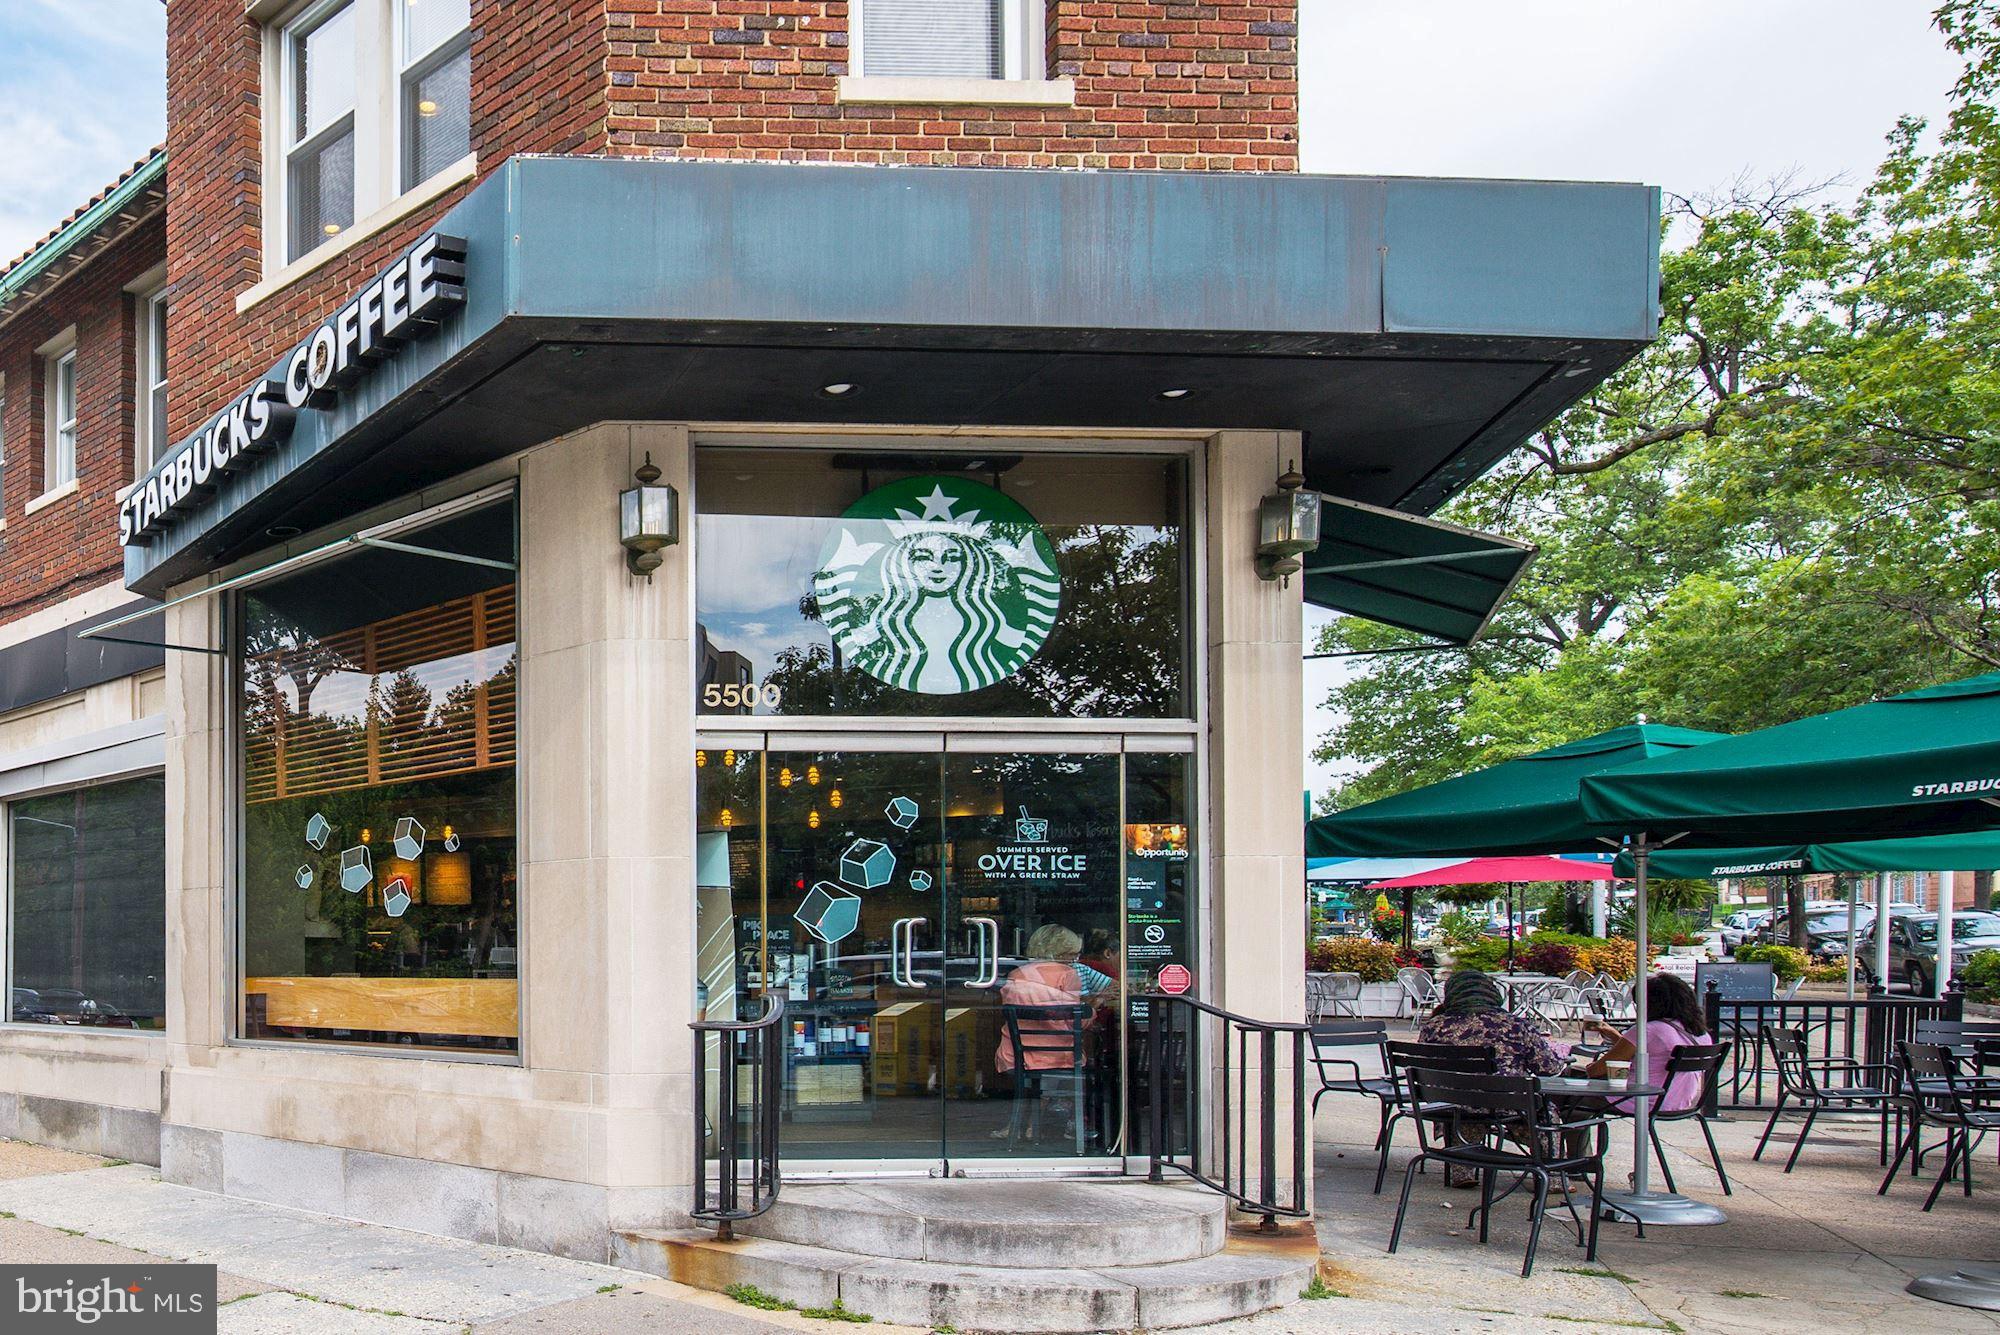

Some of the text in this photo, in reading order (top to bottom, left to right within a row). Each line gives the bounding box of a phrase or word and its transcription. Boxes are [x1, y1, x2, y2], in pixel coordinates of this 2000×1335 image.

[119, 232, 437, 546] STARBUCKS COFFEE
[703, 683, 781, 708] 5500
[996, 846, 1069, 854] SUMMER SERVED
[1136, 847, 1189, 859] Opportunity
[977, 854, 1087, 871] OVER ICE
[1711, 863, 1766, 875] STARBUCKS
[743, 920, 762, 931] PIK
[752, 930, 790, 940] PACE
